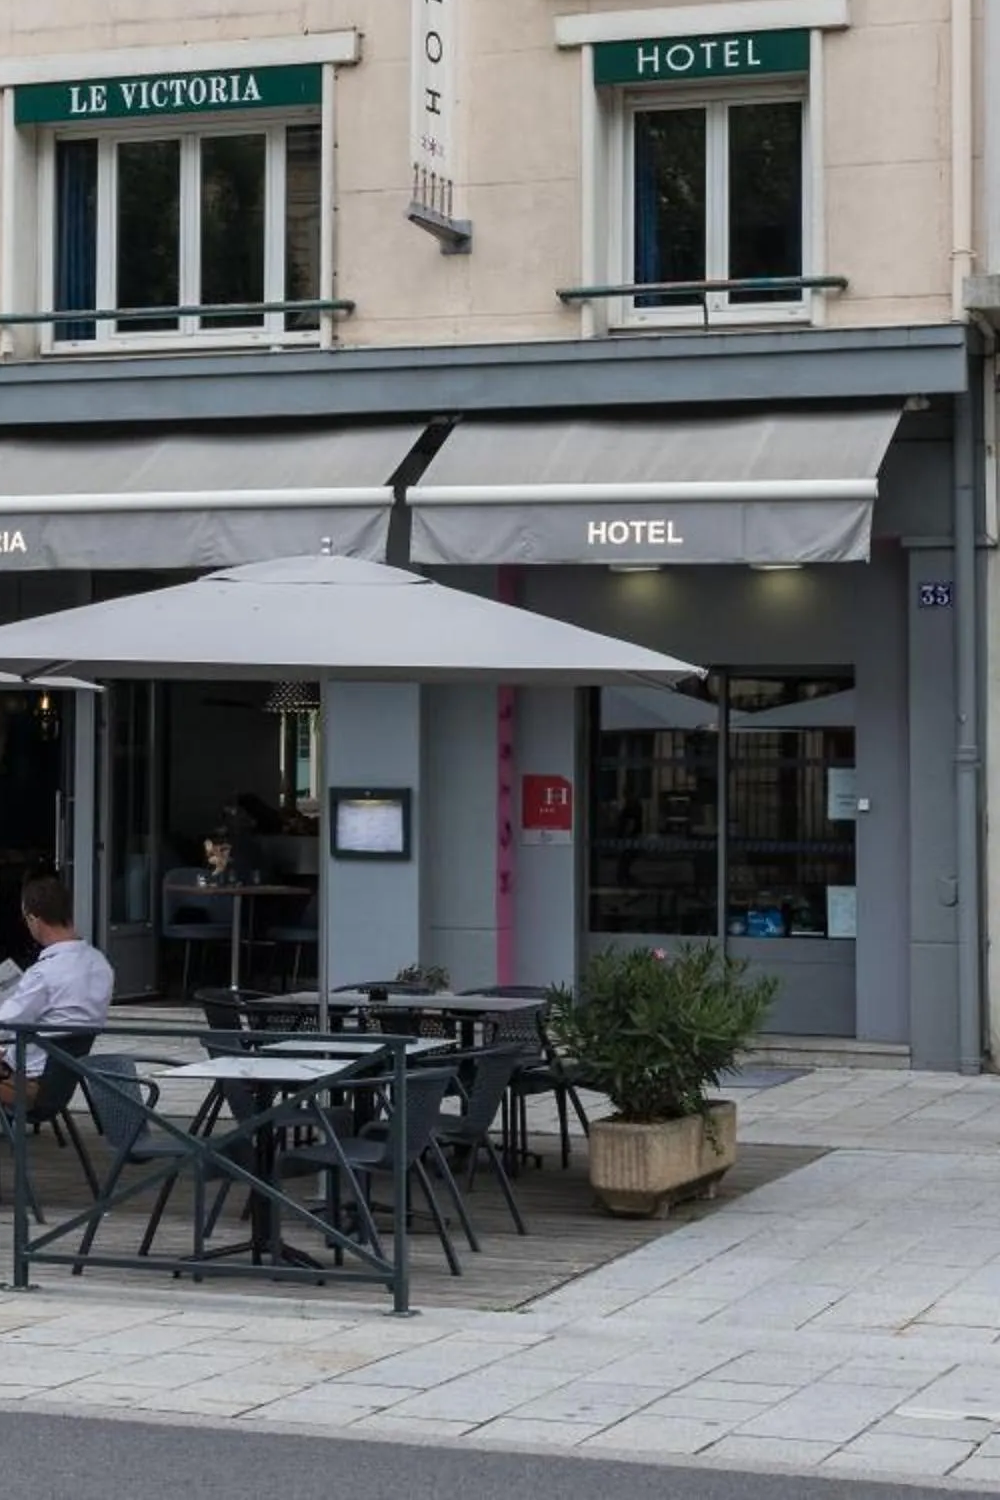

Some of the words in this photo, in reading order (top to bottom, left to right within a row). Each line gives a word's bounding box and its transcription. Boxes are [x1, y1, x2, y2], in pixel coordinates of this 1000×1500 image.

[637, 39, 761, 73] HOTEL
[69, 85, 107, 113] LE
[119, 74, 262, 109] VICTORIA
[586, 520, 684, 545] HOTEL
[920, 584, 950, 606] 35
